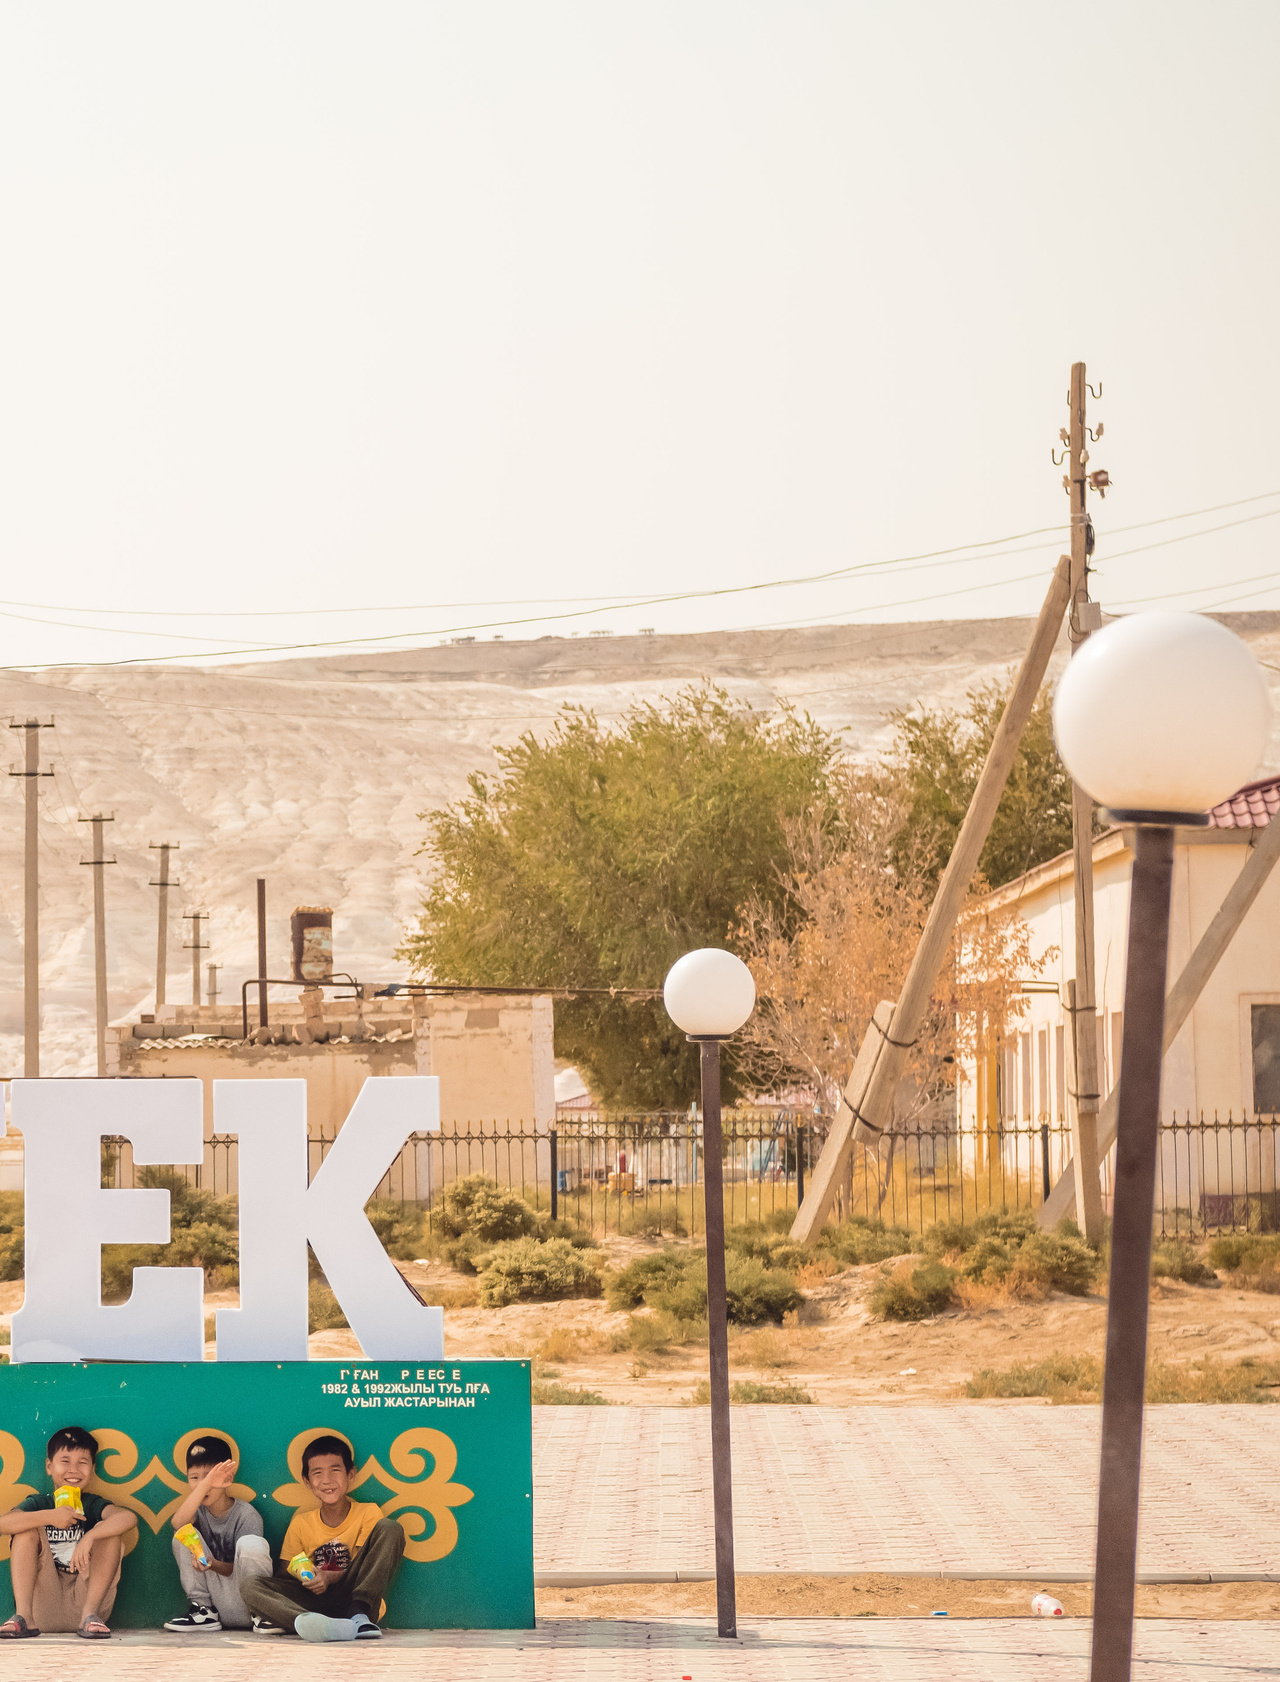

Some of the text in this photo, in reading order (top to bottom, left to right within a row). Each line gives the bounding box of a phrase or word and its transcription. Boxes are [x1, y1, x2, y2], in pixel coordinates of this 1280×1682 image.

[321, 1383, 348, 1394] 1982
[351, 1383, 362, 1394] &
[344, 1397, 475, 1408] АУЫЛ ЖАСТАРЫНАН
